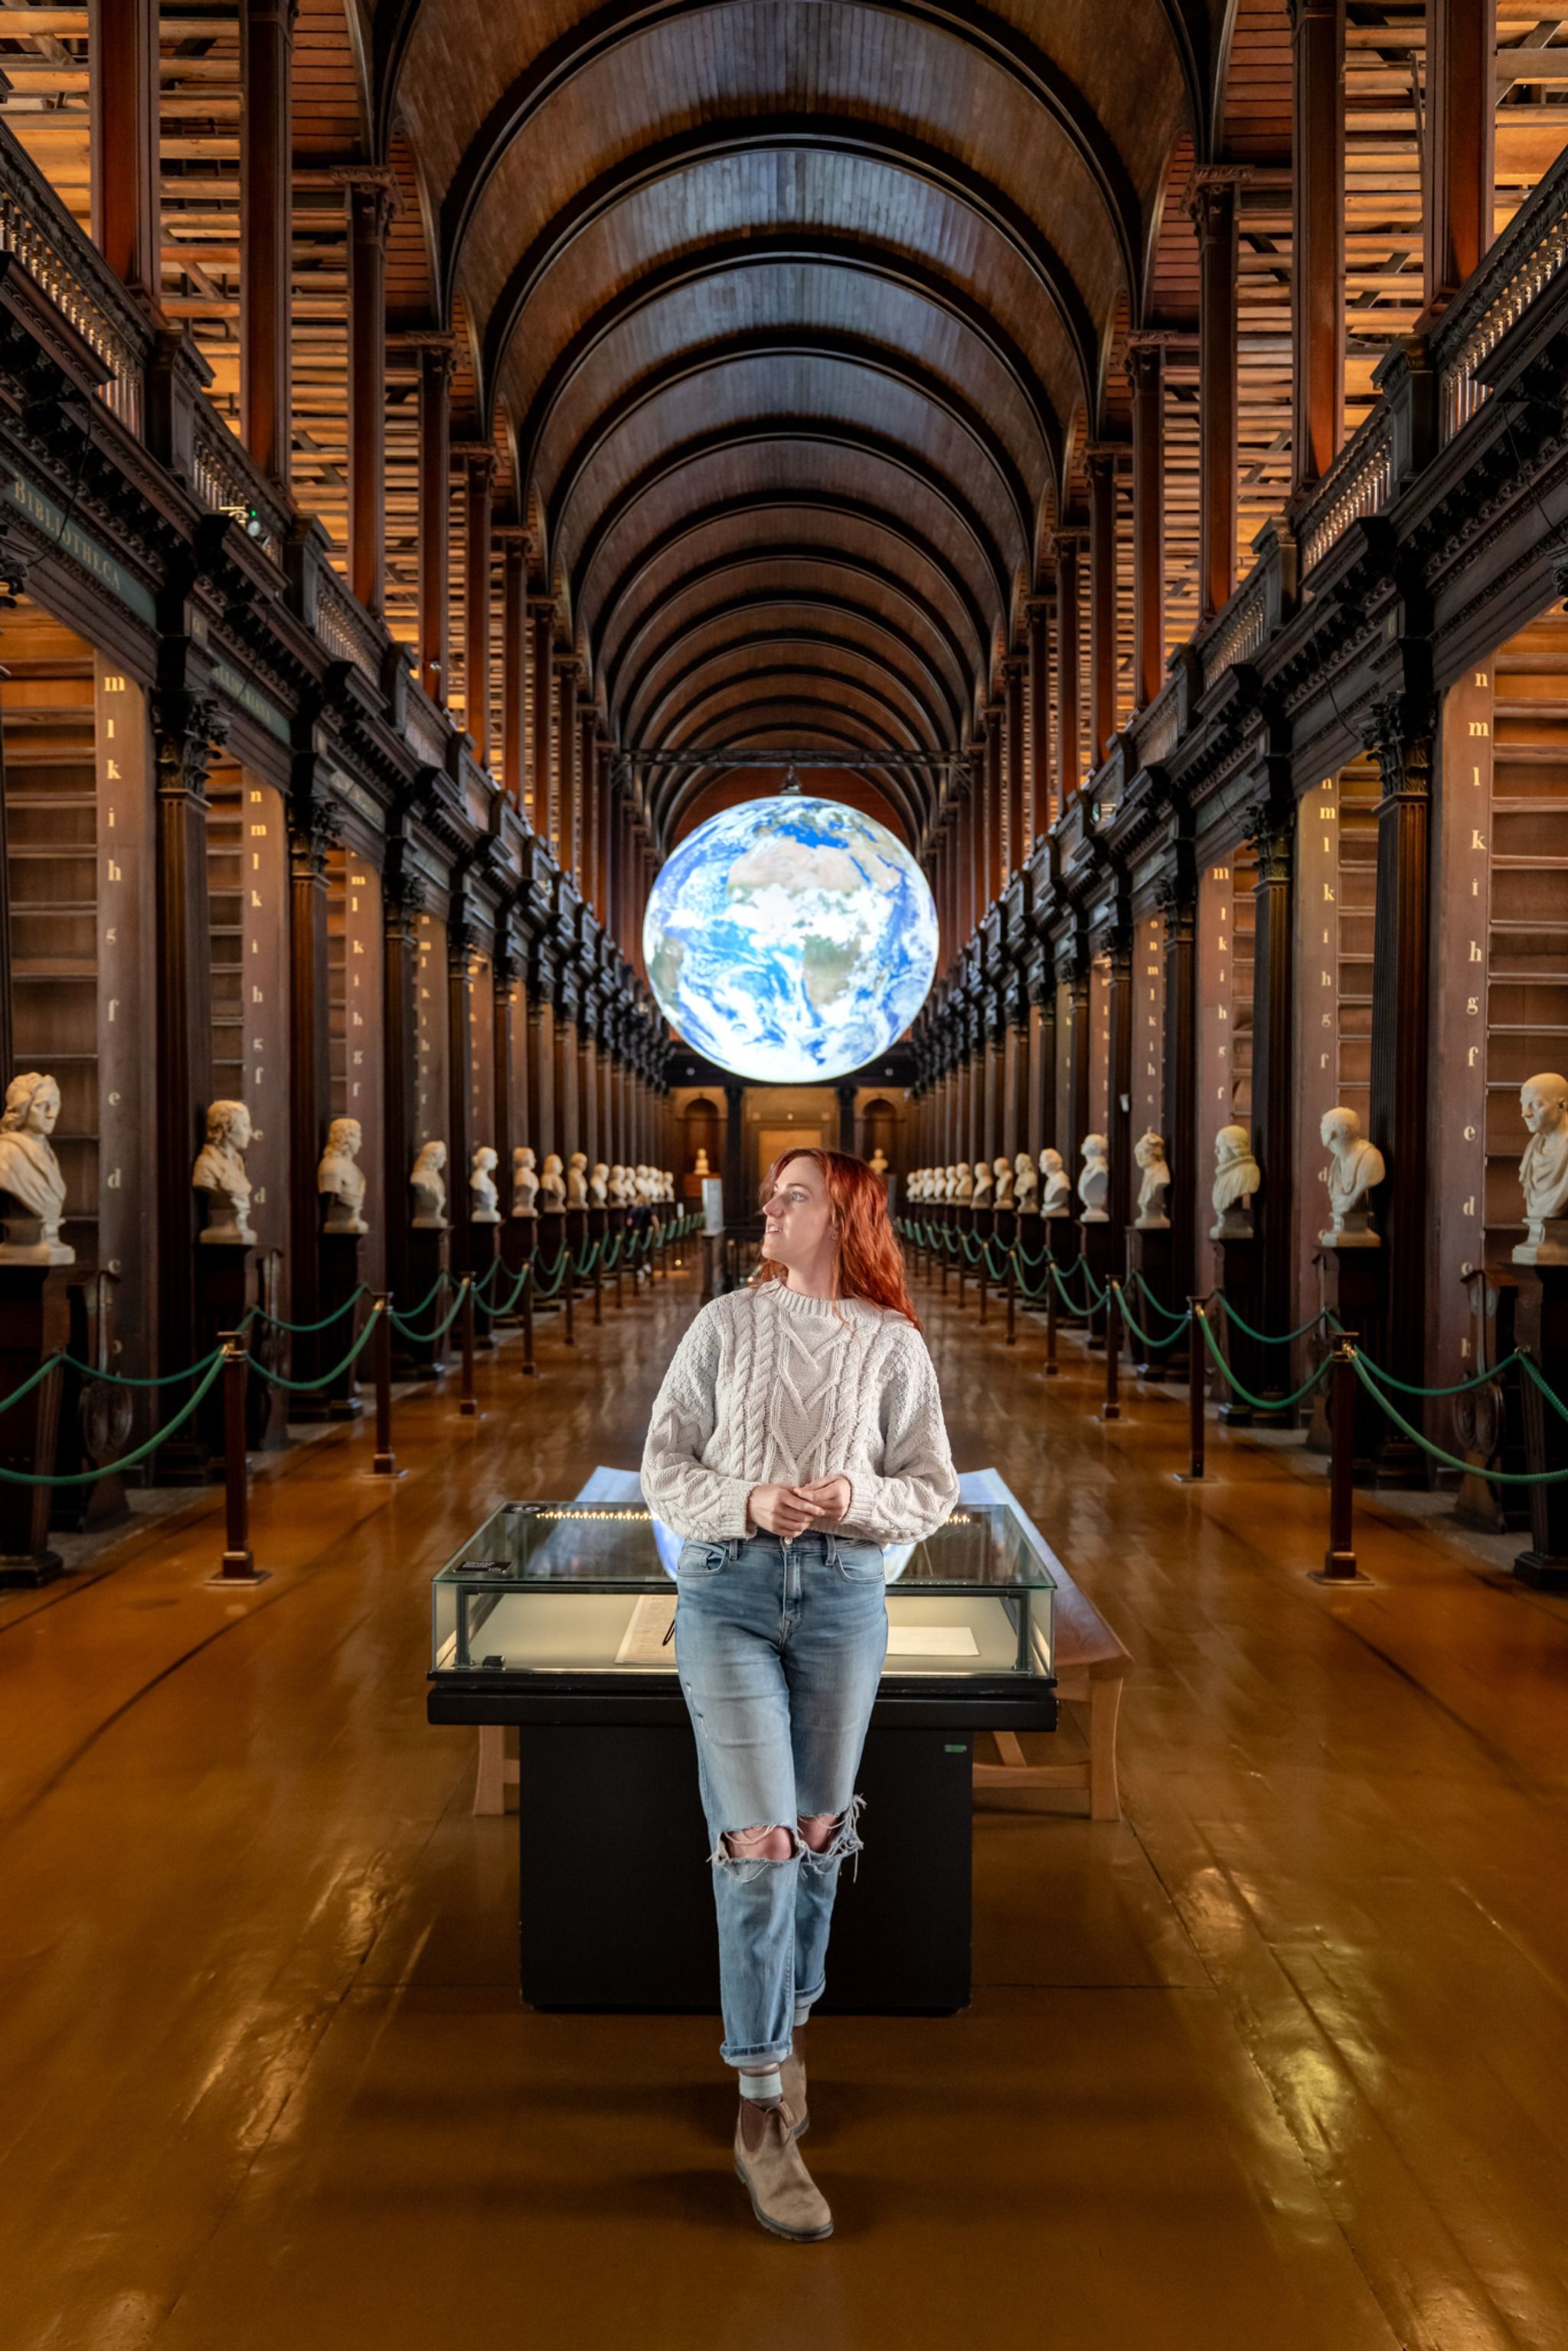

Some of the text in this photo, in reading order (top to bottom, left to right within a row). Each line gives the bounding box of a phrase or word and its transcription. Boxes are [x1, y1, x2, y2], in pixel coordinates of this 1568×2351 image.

[104, 677, 126, 692] m
[1475, 673, 1488, 687] n
[107, 719, 115, 739] l
[1468, 721, 1489, 736] m
[107, 759, 122, 779] k
[1473, 766, 1481, 786] l
[1321, 778, 1332, 790] n
[250, 791, 262, 803] n
[108, 807, 115, 828] i
[1319, 807, 1336, 820] m
[250, 824, 267, 837] m
[1323, 837, 1330, 853] l
[1472, 829, 1487, 850] k
[253, 853, 259, 870] l
[108, 859, 122, 881] h
[1323, 883, 1334, 901] k
[1472, 878, 1479, 896] i
[251, 890, 262, 907] k
[105, 928, 116, 942] g
[1322, 928, 1329, 944] i
[252, 939, 258, 954] i
[1469, 940, 1482, 962] h
[1321, 971, 1331, 986] h
[252, 985, 263, 1003] h
[108, 999, 119, 1022] f
[1466, 996, 1479, 1015] g
[1321, 1012, 1332, 1028] g
[253, 1037, 263, 1050] g
[1320, 1053, 1330, 1069] f
[1468, 1046, 1479, 1066] f
[255, 1066, 264, 1085] f
[107, 1092, 121, 1106] e
[1463, 1125, 1476, 1141] e
[106, 1167, 121, 1188] d
[1318, 1167, 1328, 1182] d
[253, 1188, 266, 1203] d
[1462, 1196, 1475, 1216] d
